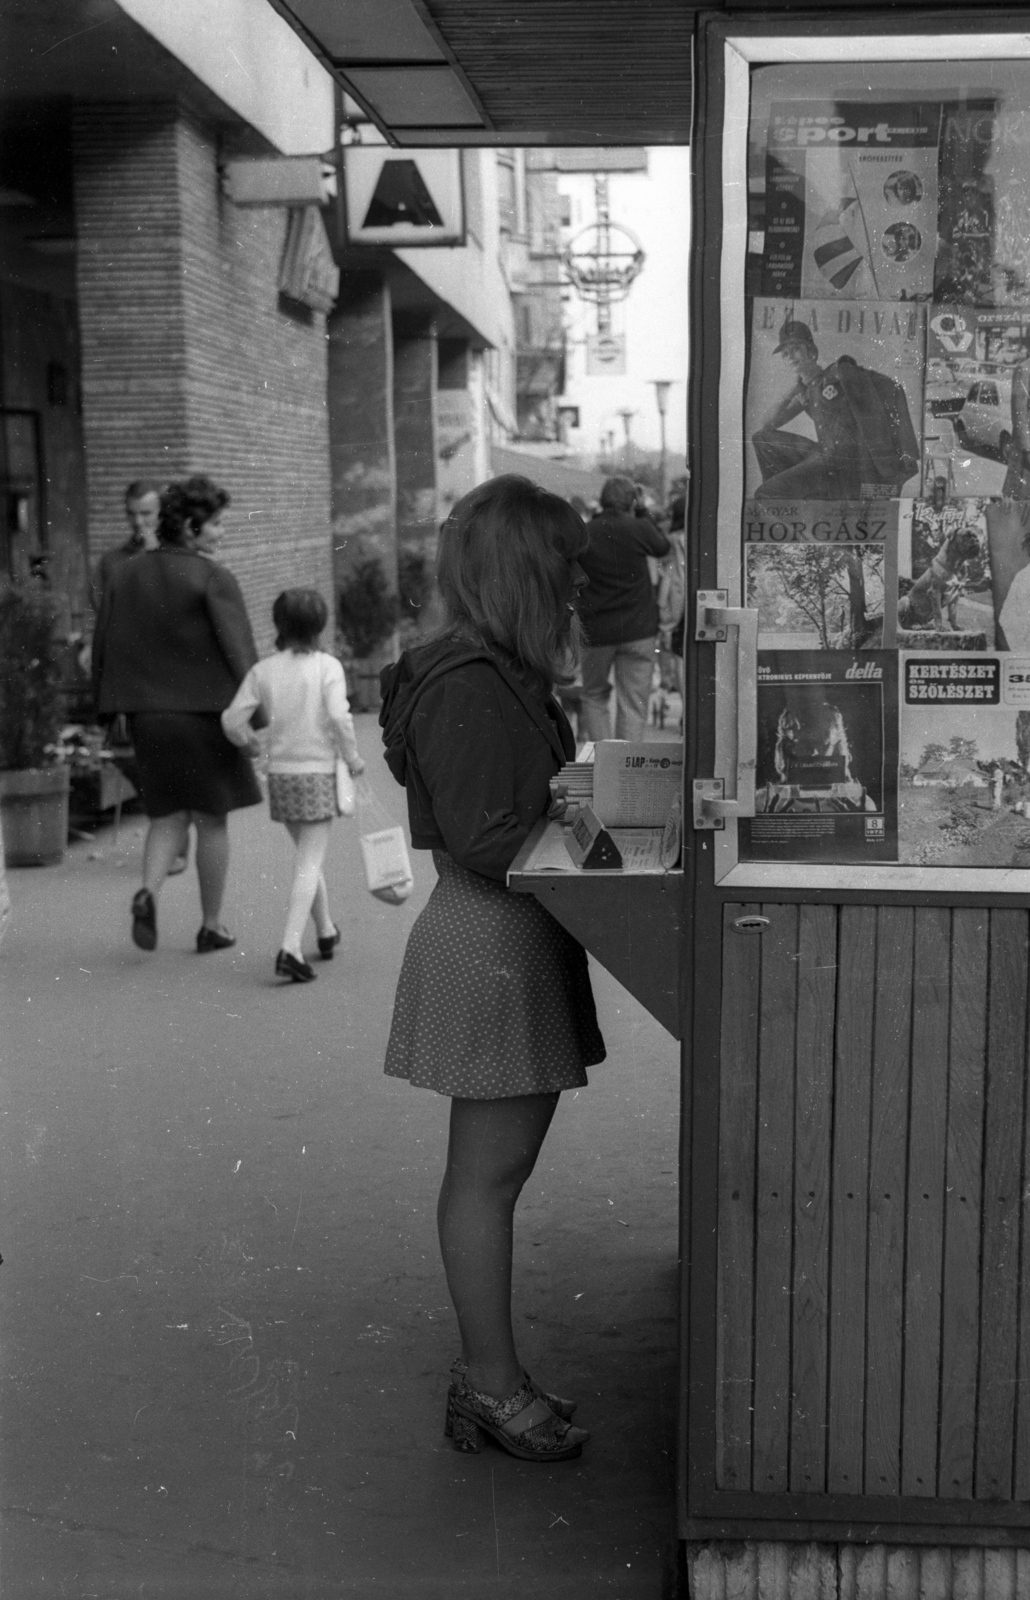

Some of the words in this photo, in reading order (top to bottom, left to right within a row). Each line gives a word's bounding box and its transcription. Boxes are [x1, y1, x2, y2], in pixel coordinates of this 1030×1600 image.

[773, 123, 892, 145] sport
[807, 308, 819, 332] A
[747, 506, 799, 516] MAGYAR
[744, 518, 887, 541] HORGÁSZ
[758, 665, 771, 674] ÖVŐ
[844, 661, 883, 680] delta
[909, 663, 996, 679] KERTÉSZET
[909, 683, 994, 699] SZŐLÉSZET
[632, 757, 645, 768] LAP
[871, 819, 878, 828] 8
